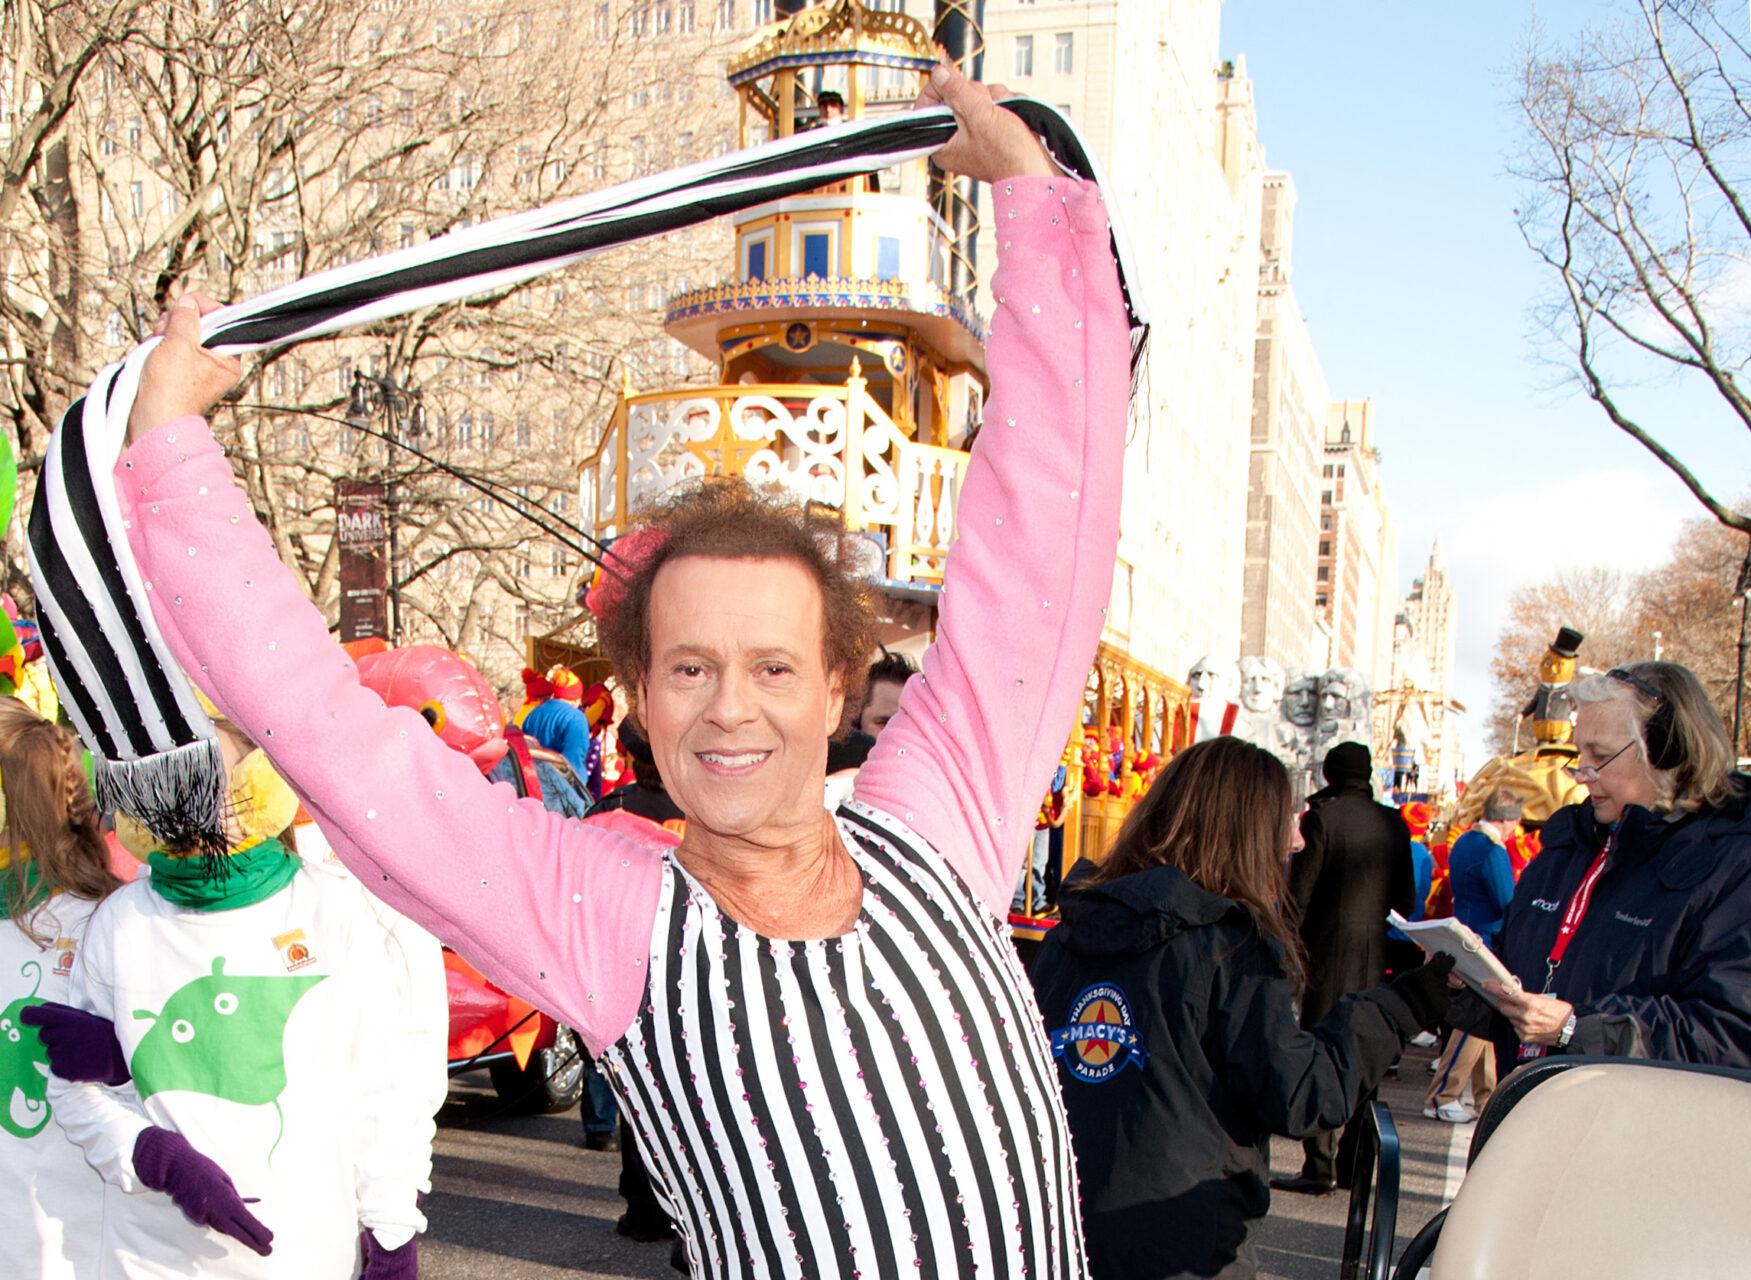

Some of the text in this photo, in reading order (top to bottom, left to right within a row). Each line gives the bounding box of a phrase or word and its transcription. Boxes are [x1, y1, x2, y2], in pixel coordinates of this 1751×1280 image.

[338, 511, 382, 530] DARK
[1070, 987, 1131, 1027] THANKSGIVING DAY
[1070, 1024, 1127, 1044] MACY'S
[1076, 1062, 1116, 1079] PARADE
